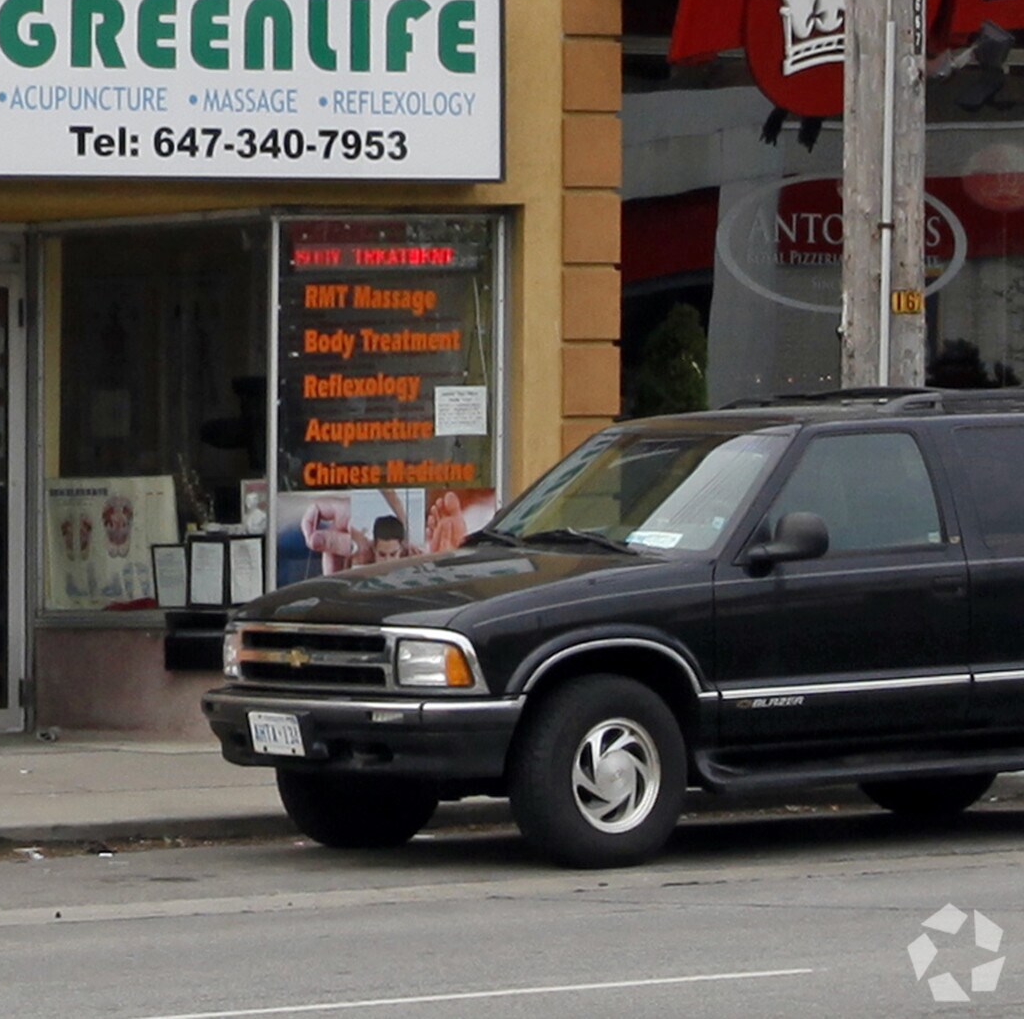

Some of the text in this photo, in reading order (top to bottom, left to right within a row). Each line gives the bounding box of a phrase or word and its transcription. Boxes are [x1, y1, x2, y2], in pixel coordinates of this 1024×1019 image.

[10, 86, 476, 116] ACUPUNCTURE MASSAGE REFLEXOLOGY
[69, 126, 408, 161] Tel: 647-340-7953
[305, 285, 437, 315] RMT Massage
[305, 328, 461, 358] Body Treatment
[304, 373, 420, 402] Reflexology
[305, 418, 433, 447] Acupuncture
[304, 459, 475, 485] Chinese Medicine
